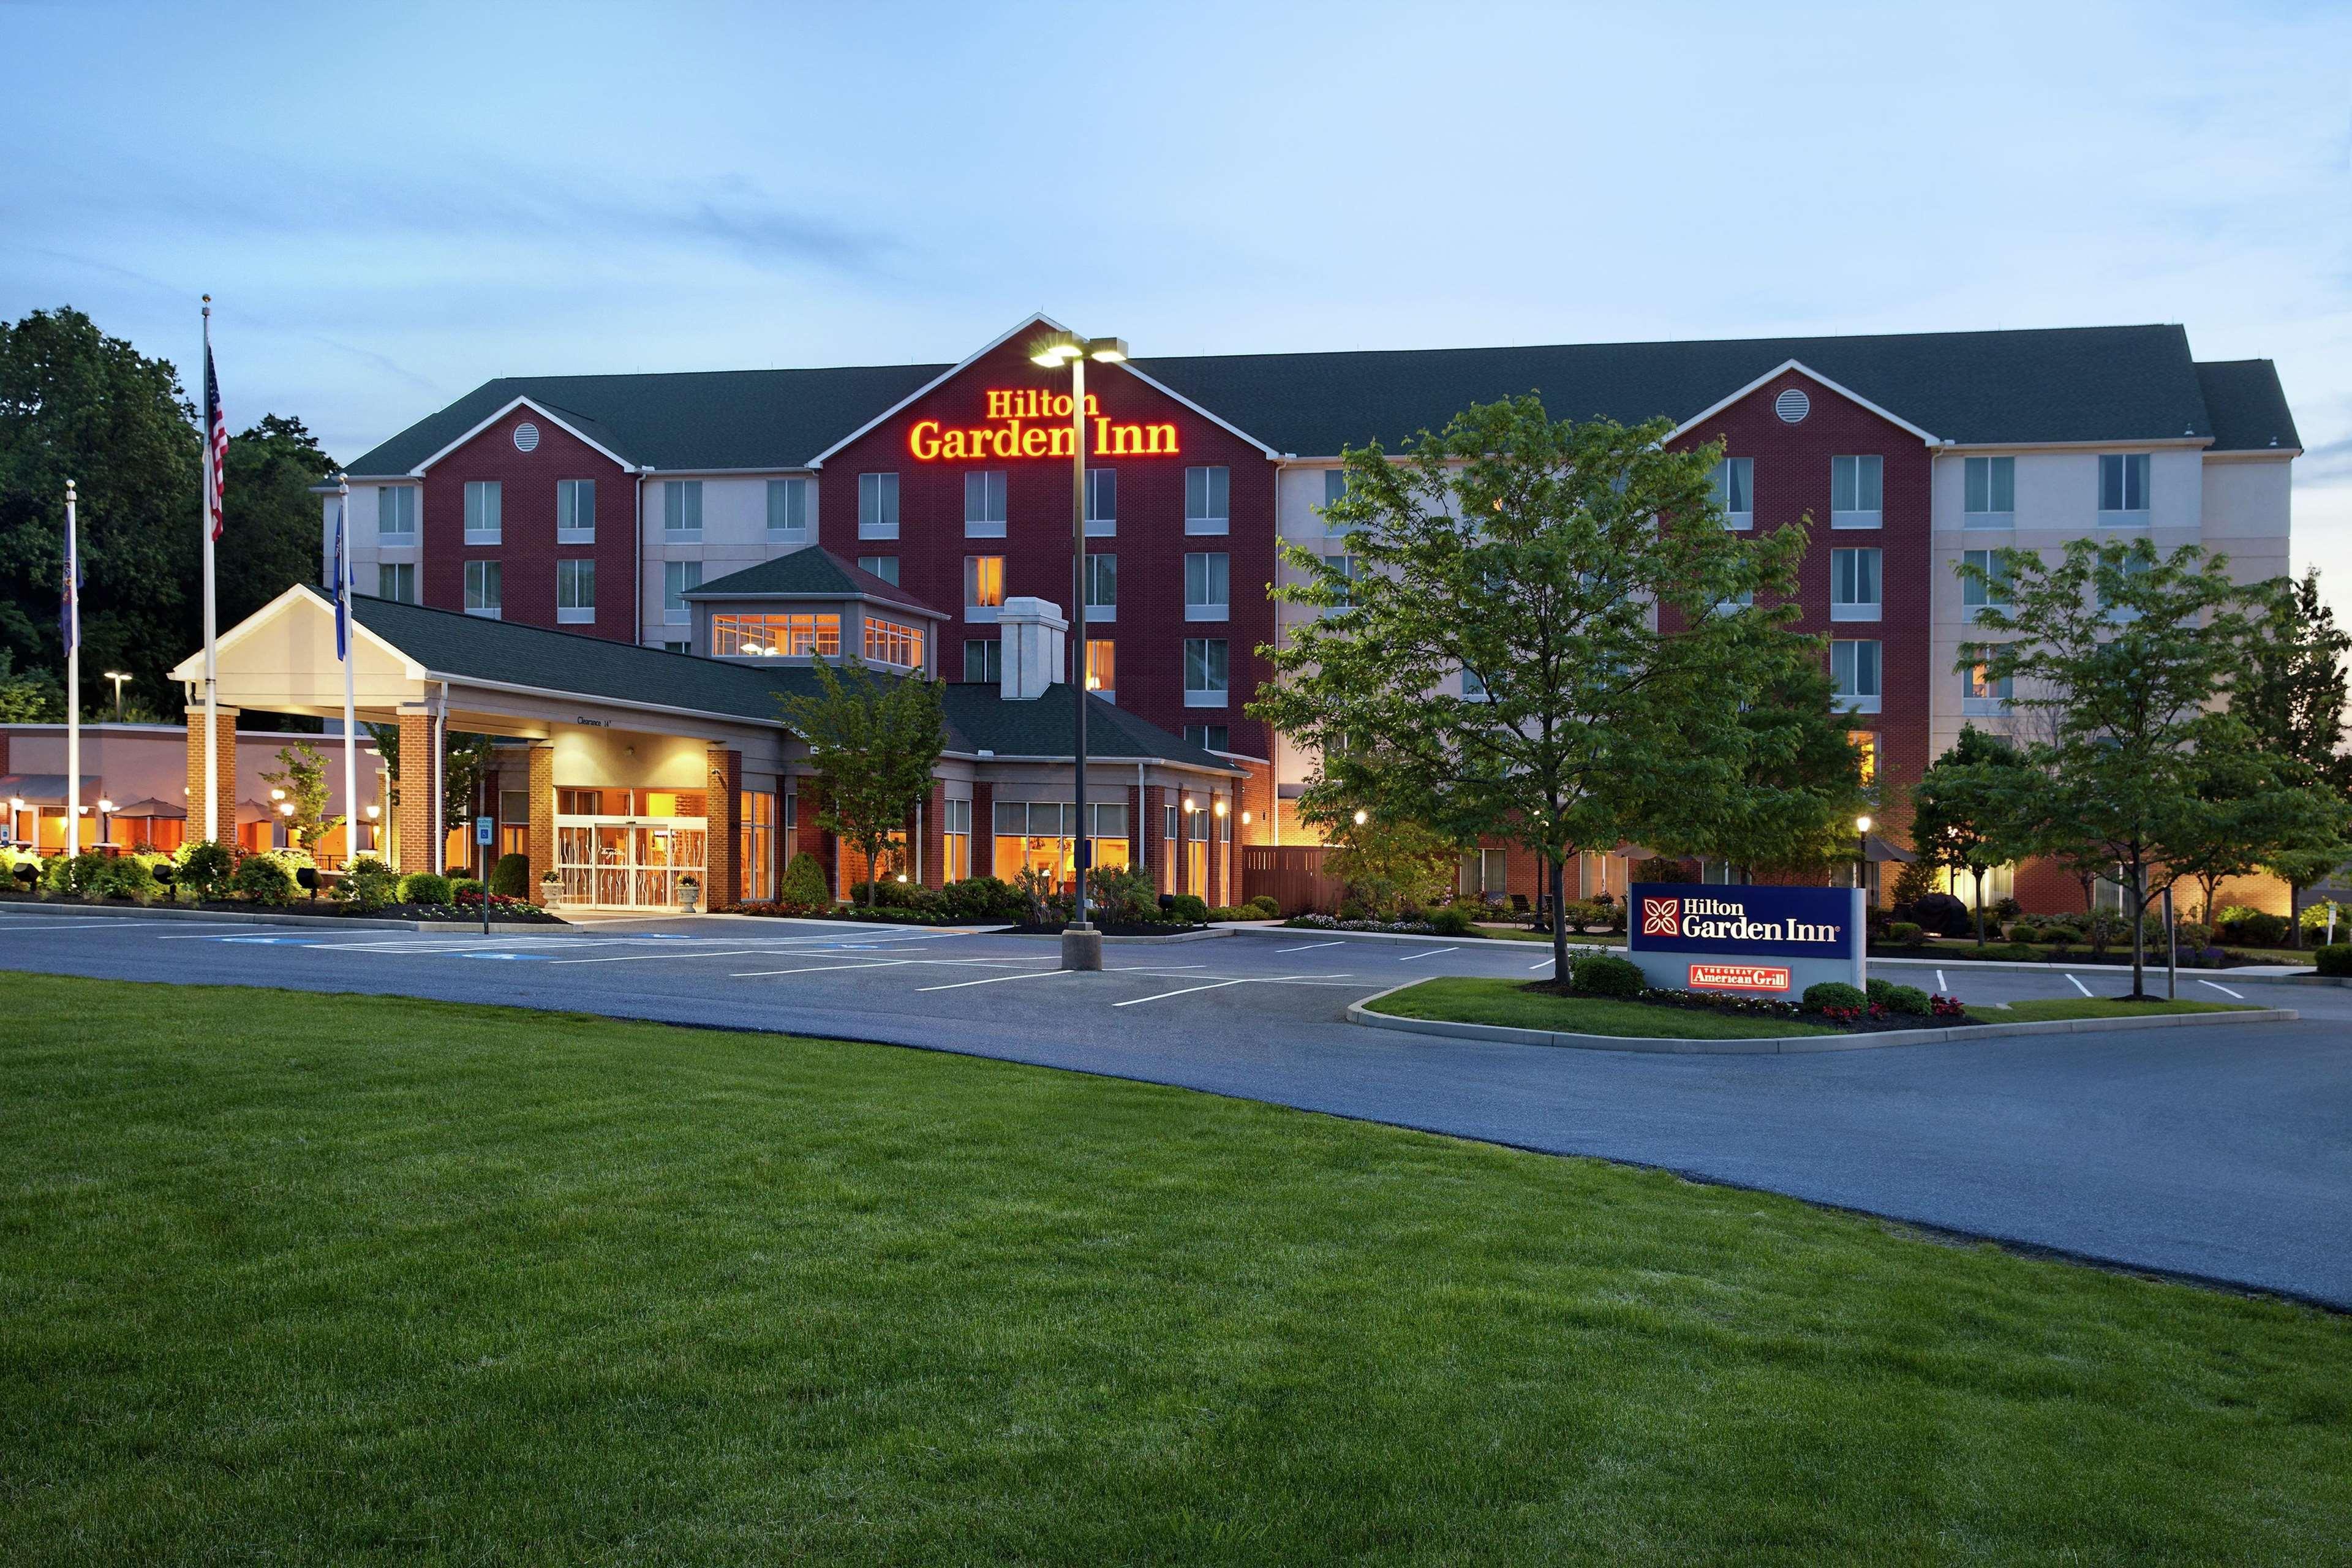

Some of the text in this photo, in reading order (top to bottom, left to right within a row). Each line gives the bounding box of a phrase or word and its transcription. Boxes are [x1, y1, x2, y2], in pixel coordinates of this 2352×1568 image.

[987, 390, 1099, 418] Hilton
[910, 417, 1180, 459] Garden Inn
[577, 716, 601, 726] Clearance
[1683, 899, 1745, 916] Hilton
[1682, 915, 1784, 940] Garden
[1693, 968, 1785, 986] American Grill
